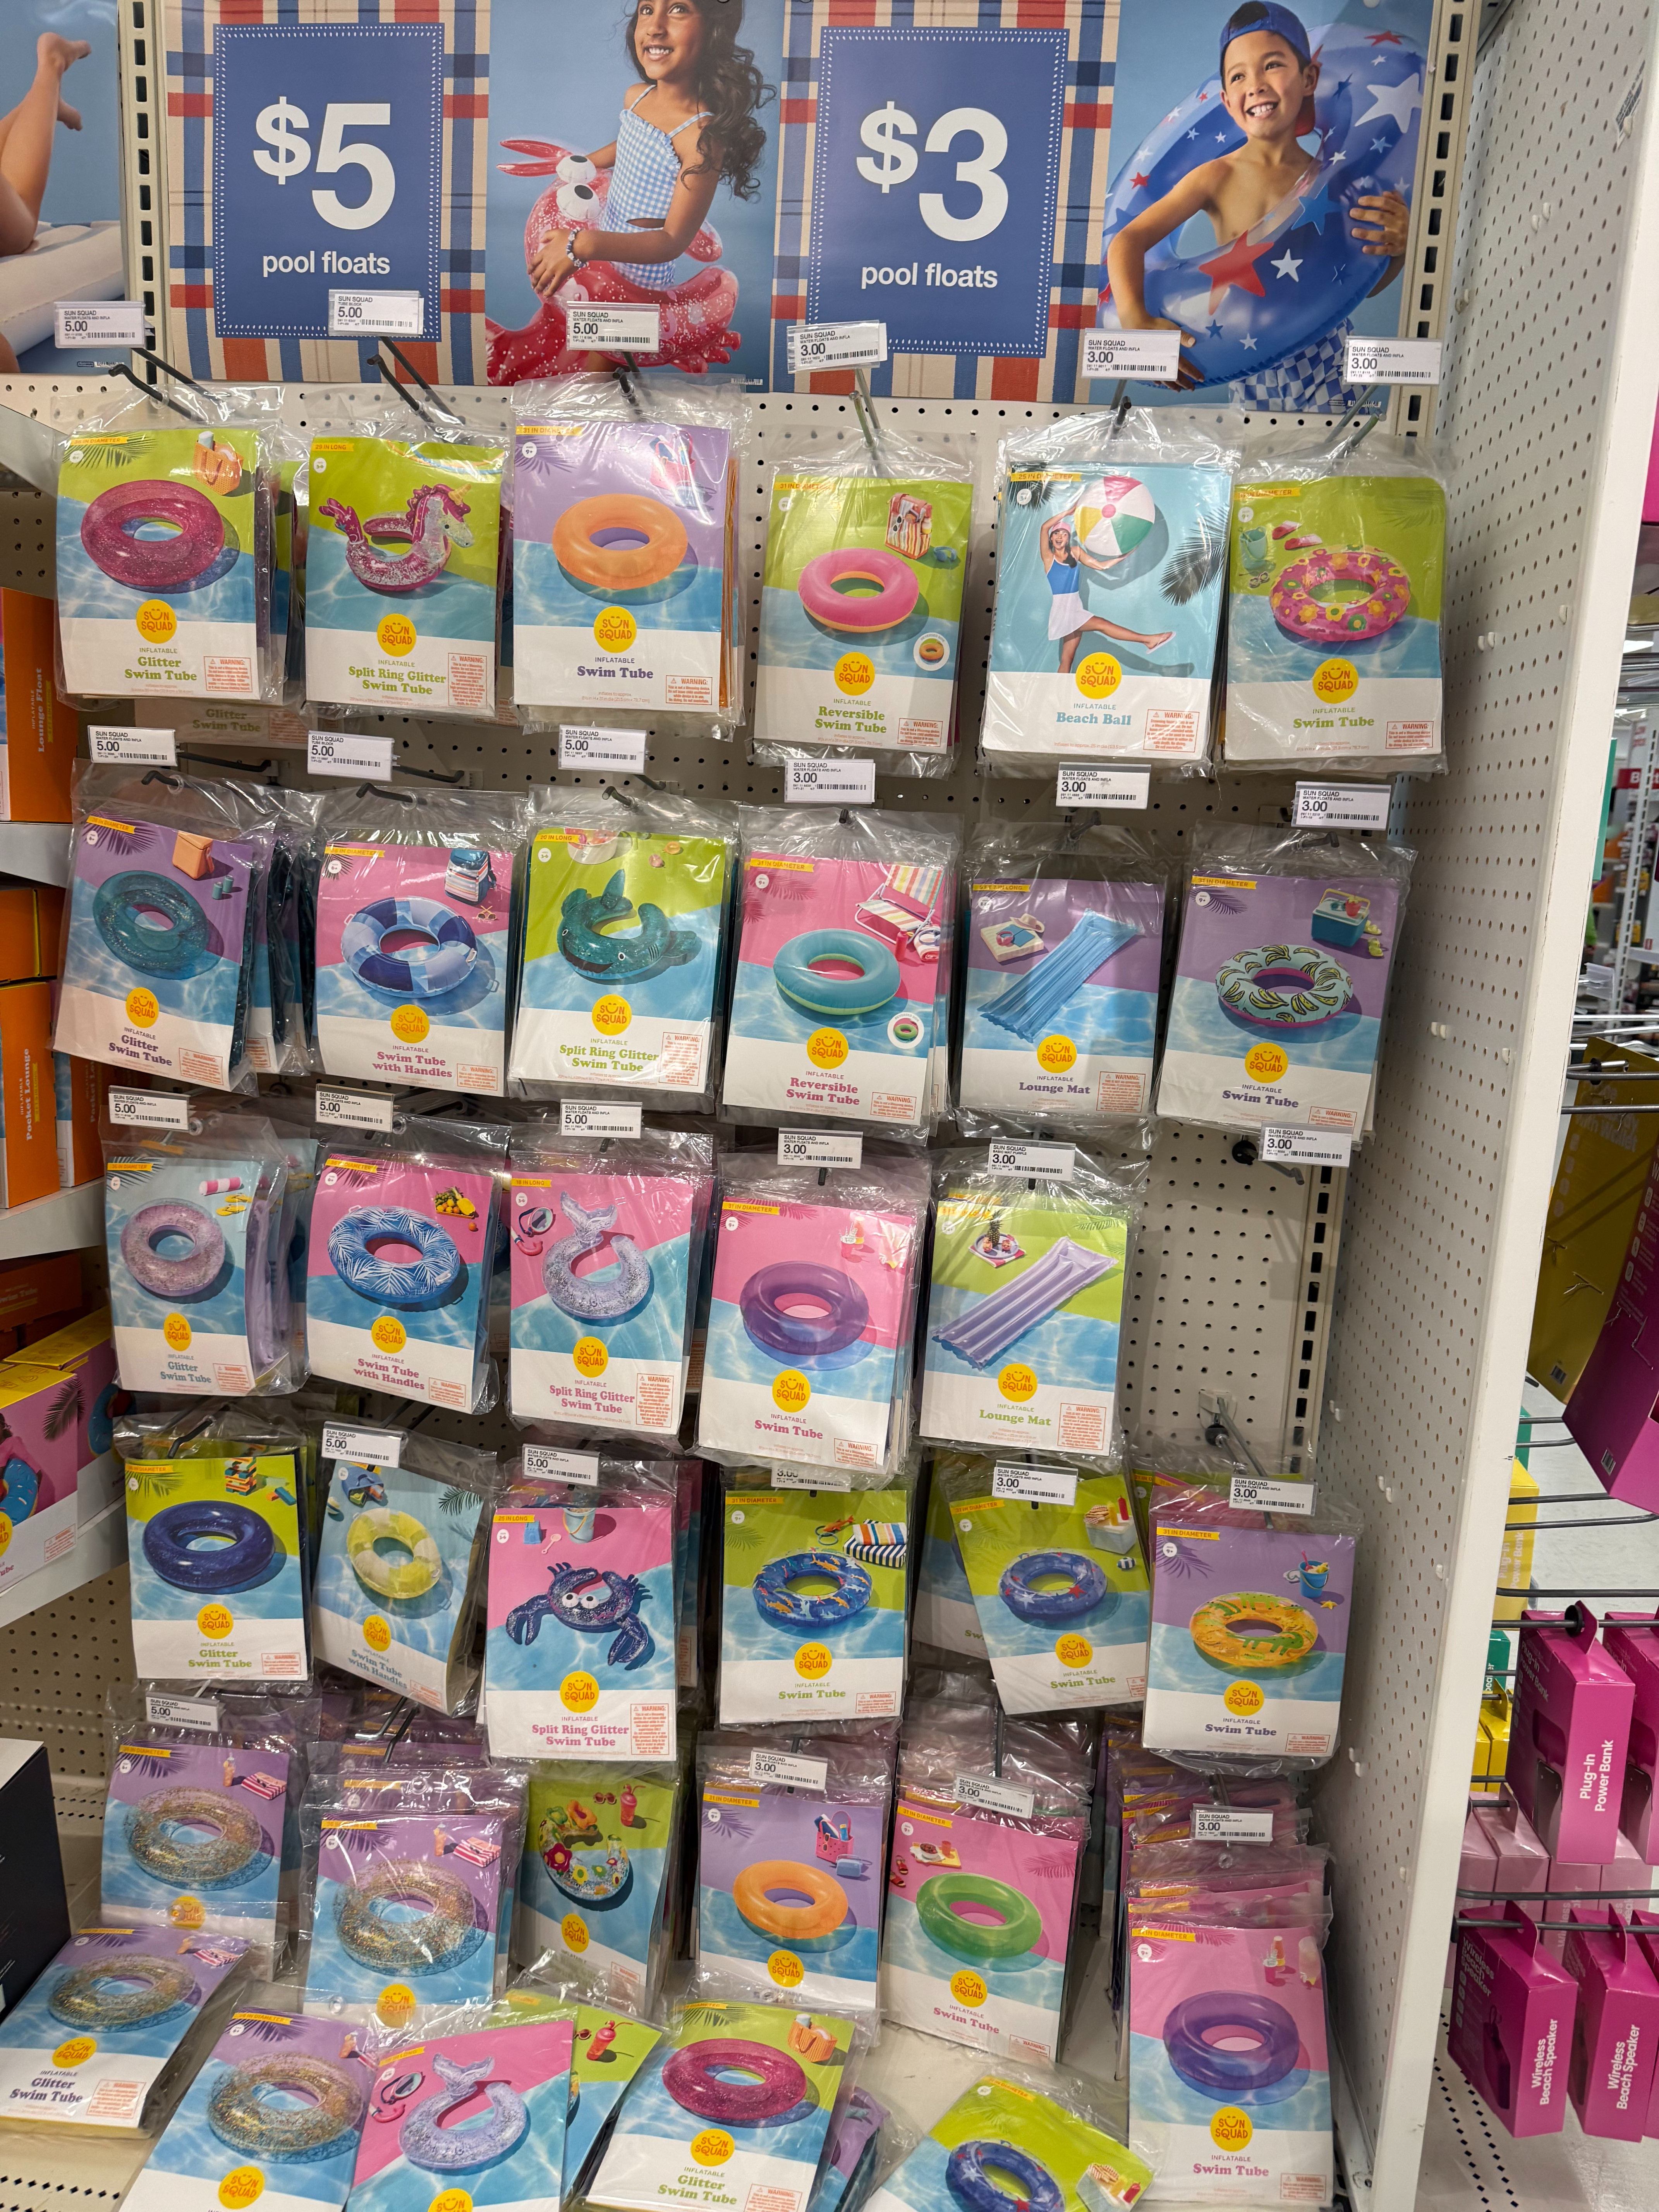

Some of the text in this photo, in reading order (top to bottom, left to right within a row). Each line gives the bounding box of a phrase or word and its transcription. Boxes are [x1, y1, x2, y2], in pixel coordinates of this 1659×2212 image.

[253, 96, 395, 230] $5
[857, 101, 1008, 241] $3
[263, 251, 390, 277] pool floats
[861, 263, 998, 289] pool floats
[338, 307, 362, 318] 5.00
[65, 321, 88, 332] 5.00
[573, 323, 598, 334] 5.00
[800, 343, 826, 356] 3.00
[1088, 352, 1113, 363] 3.00
[1352, 357, 1377, 369] 3.00
[138, 657, 182, 668] Glitter
[125, 669, 197, 682] Swim Tube
[349, 666, 446, 683] Split Ring Glitter
[577, 666, 654, 680] Swim Tube
[1085, 665, 1114, 675] SUN
[362, 680, 433, 696] Swim Tube
[1081, 674, 1116, 688] SQUAD
[819, 706, 884, 721] Reversible
[1056, 711, 1132, 726] Beach Ball
[815, 720, 887, 734] Swim Tube
[1293, 716, 1374, 730] Swim Tube
[96, 741, 120, 752] 5.00
[311, 745, 334, 757] 5.00
[565, 740, 589, 752] 5.00
[793, 772, 817, 784] 3.00
[1061, 781, 1086, 793] 3.00
[1302, 801, 1327, 812] 3.00
[121, 1034, 158, 1053] Glitter
[108, 1042, 172, 1067] Swim Tube
[376, 1050, 446, 1067] Swim Tube
[560, 1044, 659, 1062] Split Ring Glitter
[372, 1061, 453, 1079] with Handles
[572, 1058, 644, 1073] Swim Tube
[790, 1077, 858, 1095] Reversible
[1019, 1082, 1091, 1095] Lounge Mat
[786, 1088, 860, 1106] Swim Tube
[1223, 1089, 1299, 1108] Swim Tube
[114, 1103, 136, 1115] 5.00
[319, 1101, 340, 1113] 5.00
[565, 1114, 587, 1125] 5.00
[784, 1144, 806, 1155] 3.00
[1268, 1138, 1292, 1149] 3.00
[992, 1154, 1015, 1165] 3.00
[168, 1361, 198, 1372] Glitter
[358, 1358, 419, 1378] Swim Tube
[160, 1371, 212, 1383] Swim Tube
[353, 1367, 425, 1390] with Handles
[550, 1385, 635, 1403] Split Ring Glitter
[561, 1398, 623, 1414] Swim Tube
[997, 1404, 1034, 1412] INFLATABLE
[979, 1409, 1052, 1426] Lounge Mat
[754, 1420, 823, 1439] Swim Tube
[326, 1438, 347, 1449] 5.00
[527, 1457, 548, 1468] 5.00
[997, 1477, 1019, 1488] 3.00
[1234, 1488, 1257, 1499] 3.00
[199, 1649, 238, 1659] Glitter
[188, 1659, 252, 1668] Swim Tube
[351, 1649, 402, 1678] Swim Tube
[347, 1656, 408, 1690] with Handles
[1050, 1675, 1116, 1689] Swim Tube
[778, 1689, 846, 1700] Swim Tube
[151, 1706, 171, 1716] 5.00
[532, 1725, 629, 1737] Split Ring Glitter
[1204, 1724, 1277, 1736] Swim Tube
[546, 1736, 616, 1747] Swim Tube
[755, 1762, 776, 1774] 3.00
[1580, 1754, 1595, 1799] Plug-In
[1595, 1740, 1614, 1812] Power Bank
[959, 1787, 980, 1798] 3.00
[1199, 1821, 1221, 1832] 3.00
[933, 2007, 1000, 2036] Swim Tube
[1532, 2038, 1546, 2088] Wireless
[1540, 2019, 1558, 2105] Beach Speaker
[1607, 2042, 1625, 2089] Wireless
[1616, 2024, 1640, 2109] Beach Speaker
[31, 2078, 75, 2091] Glitter
[9, 2088, 83, 2104] Swim Tube
[1193, 2163, 1269, 2177] Swim Tube
[677, 2174, 726, 2192] Glitter
[658, 2185, 737, 2206] Swim Tube
